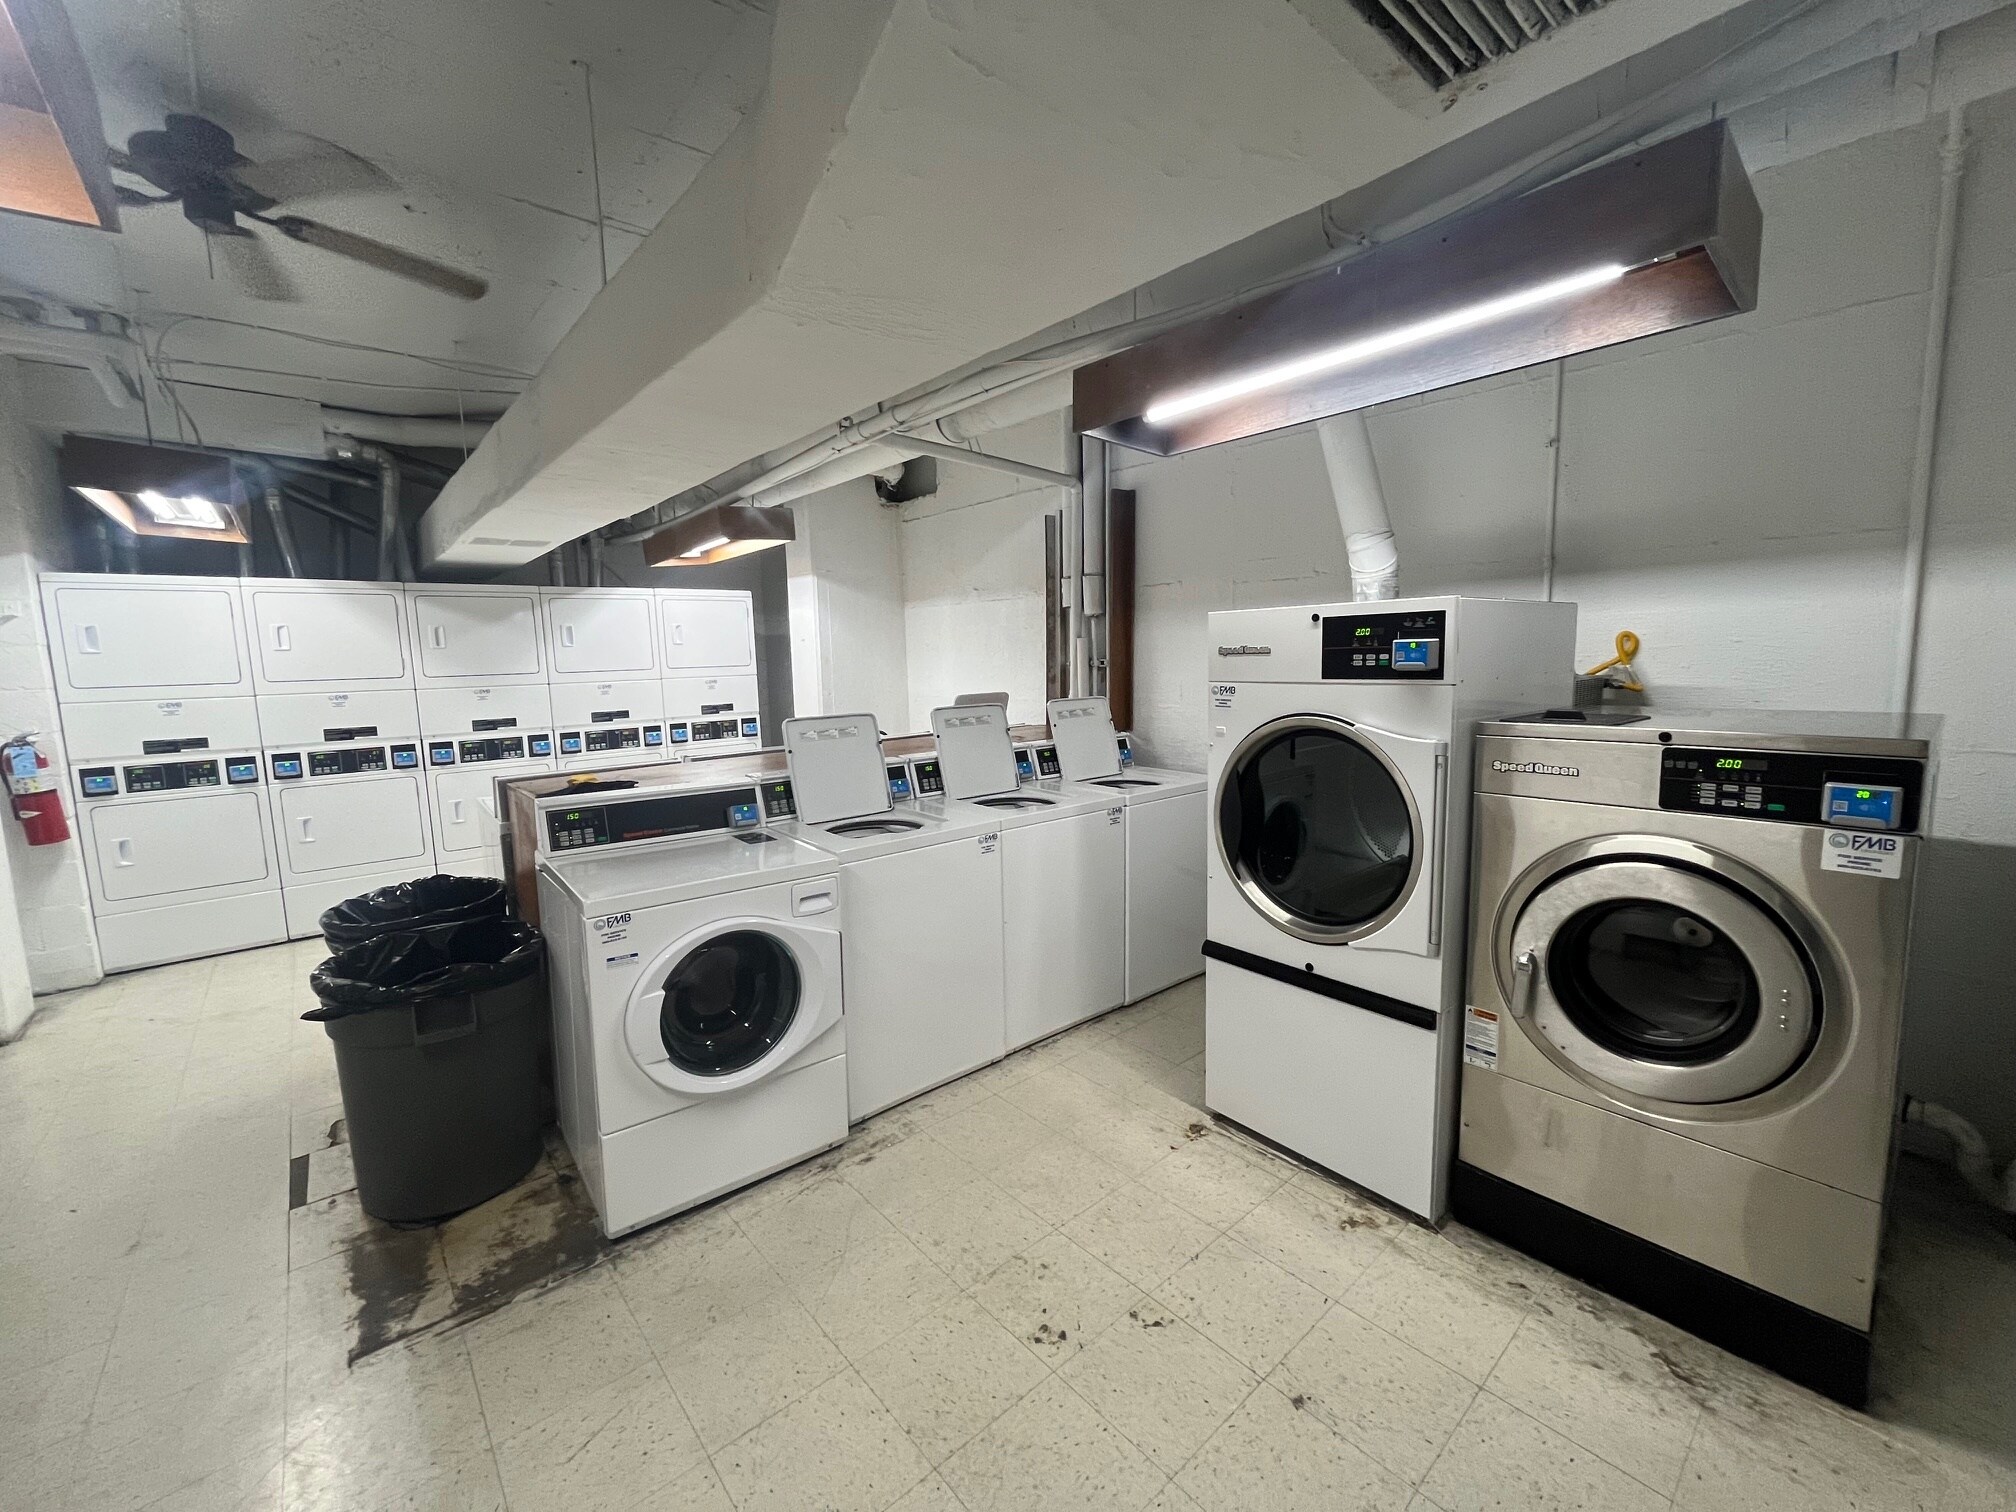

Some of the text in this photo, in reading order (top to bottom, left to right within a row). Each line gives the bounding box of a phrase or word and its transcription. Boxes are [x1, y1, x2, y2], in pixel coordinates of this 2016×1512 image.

[1492, 760, 1579, 777] Speed Queen
[1716, 759, 1742, 769] 2.00
[1851, 835, 1897, 852] FMB
[606, 913, 632, 929] FMB
